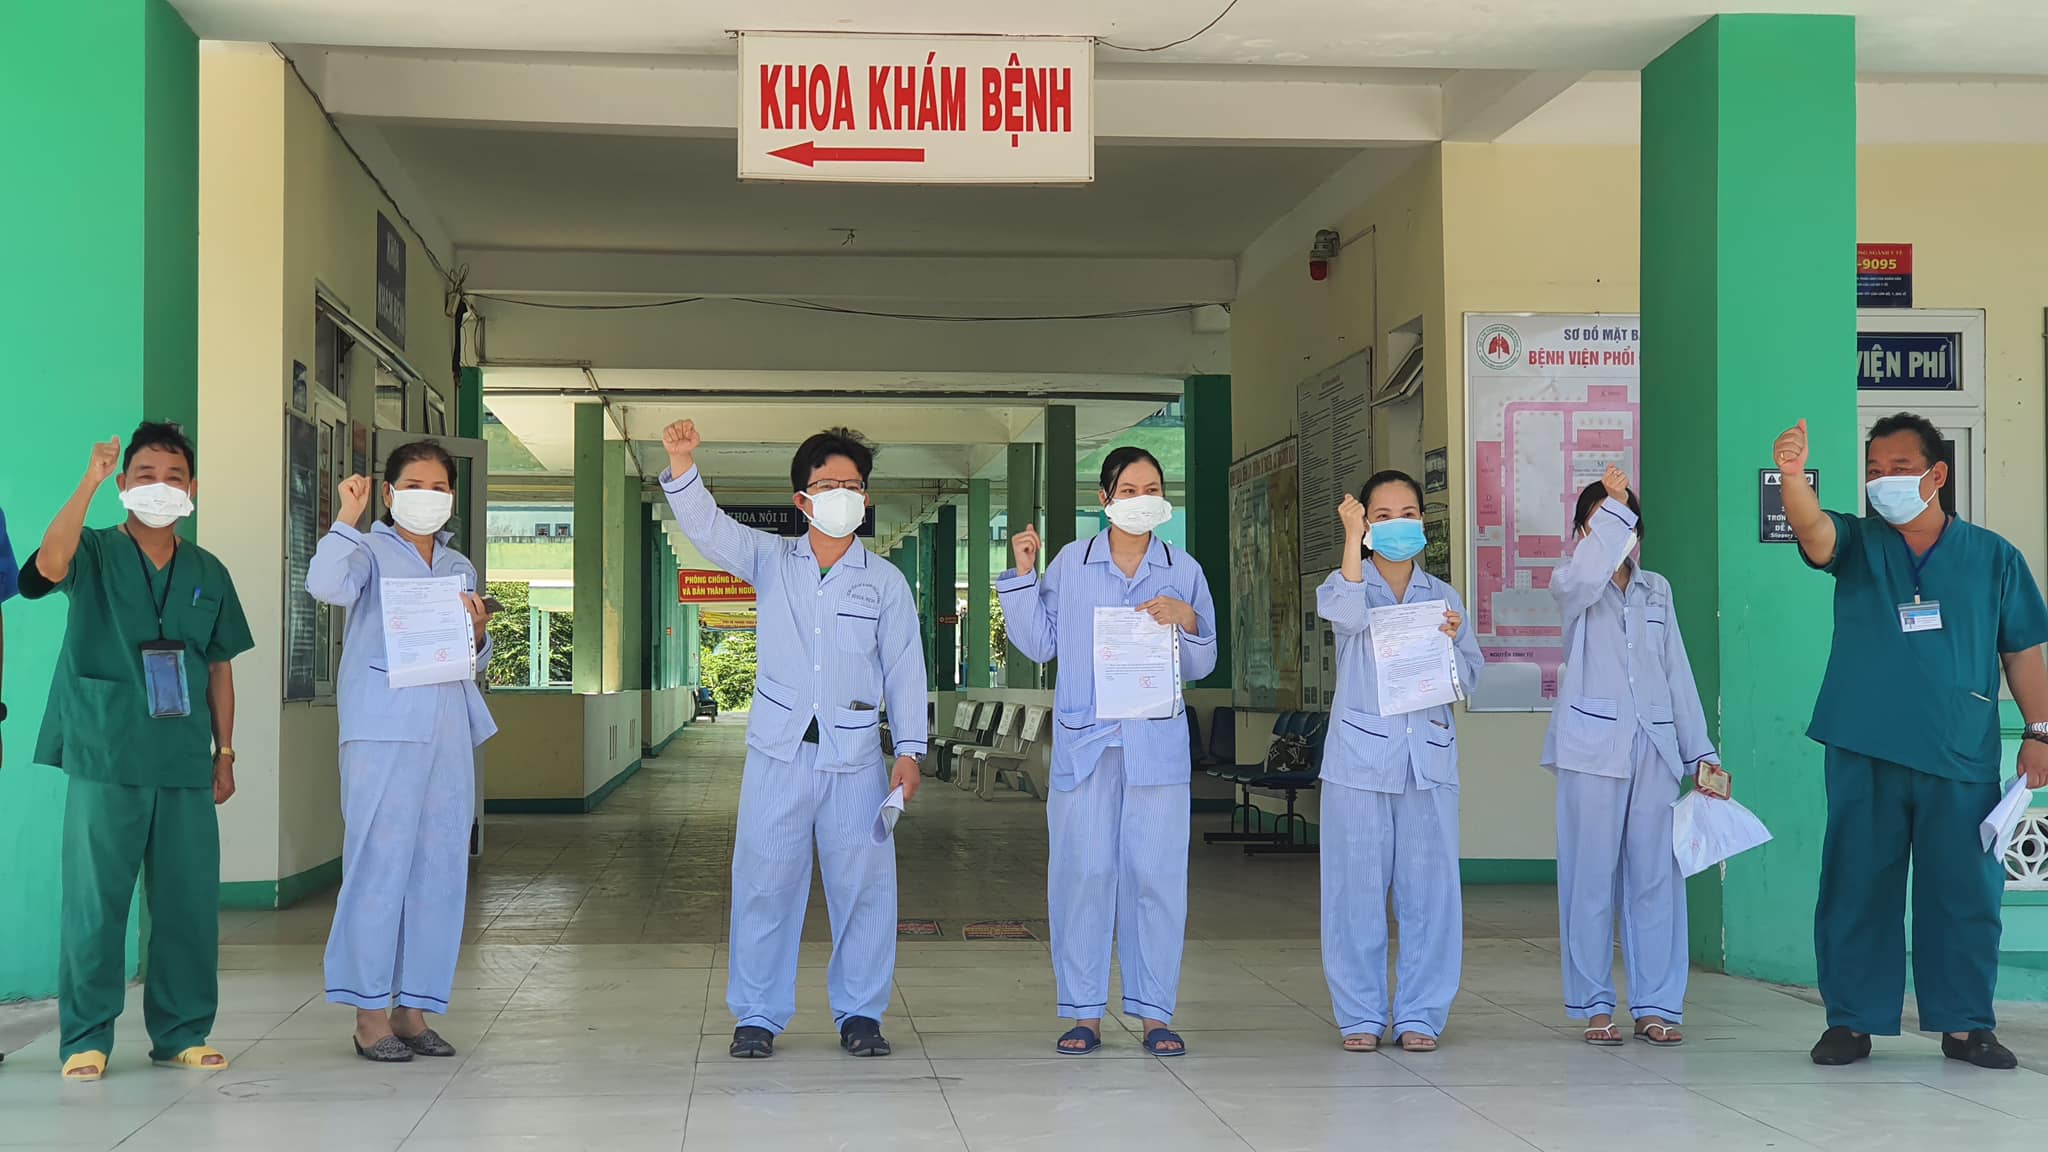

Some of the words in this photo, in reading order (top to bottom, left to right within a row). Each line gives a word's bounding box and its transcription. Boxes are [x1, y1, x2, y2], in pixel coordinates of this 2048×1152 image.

[760, 64, 856, 131] KHOA
[869, 51, 966, 131] KHÁM
[982, 52, 1071, 148] BỆNH
[1564, 328, 1580, 340] SƠ
[1583, 325, 1599, 341] ĐỒ
[1602, 328, 1627, 344] MẶT
[1631, 329, 1641, 341] B
[1528, 347, 1565, 369] BỆNH
[1568, 348, 1599, 369] VIỆN
[1603, 346, 1635, 366] PHỔI
[1908, 345, 1948, 378] PHÍ
[759, 510, 777, 524] NỘI
[780, 512, 788, 523] II
[685, 575, 707, 584] PHÒNG
[708, 574, 730, 584] CHỐNG
